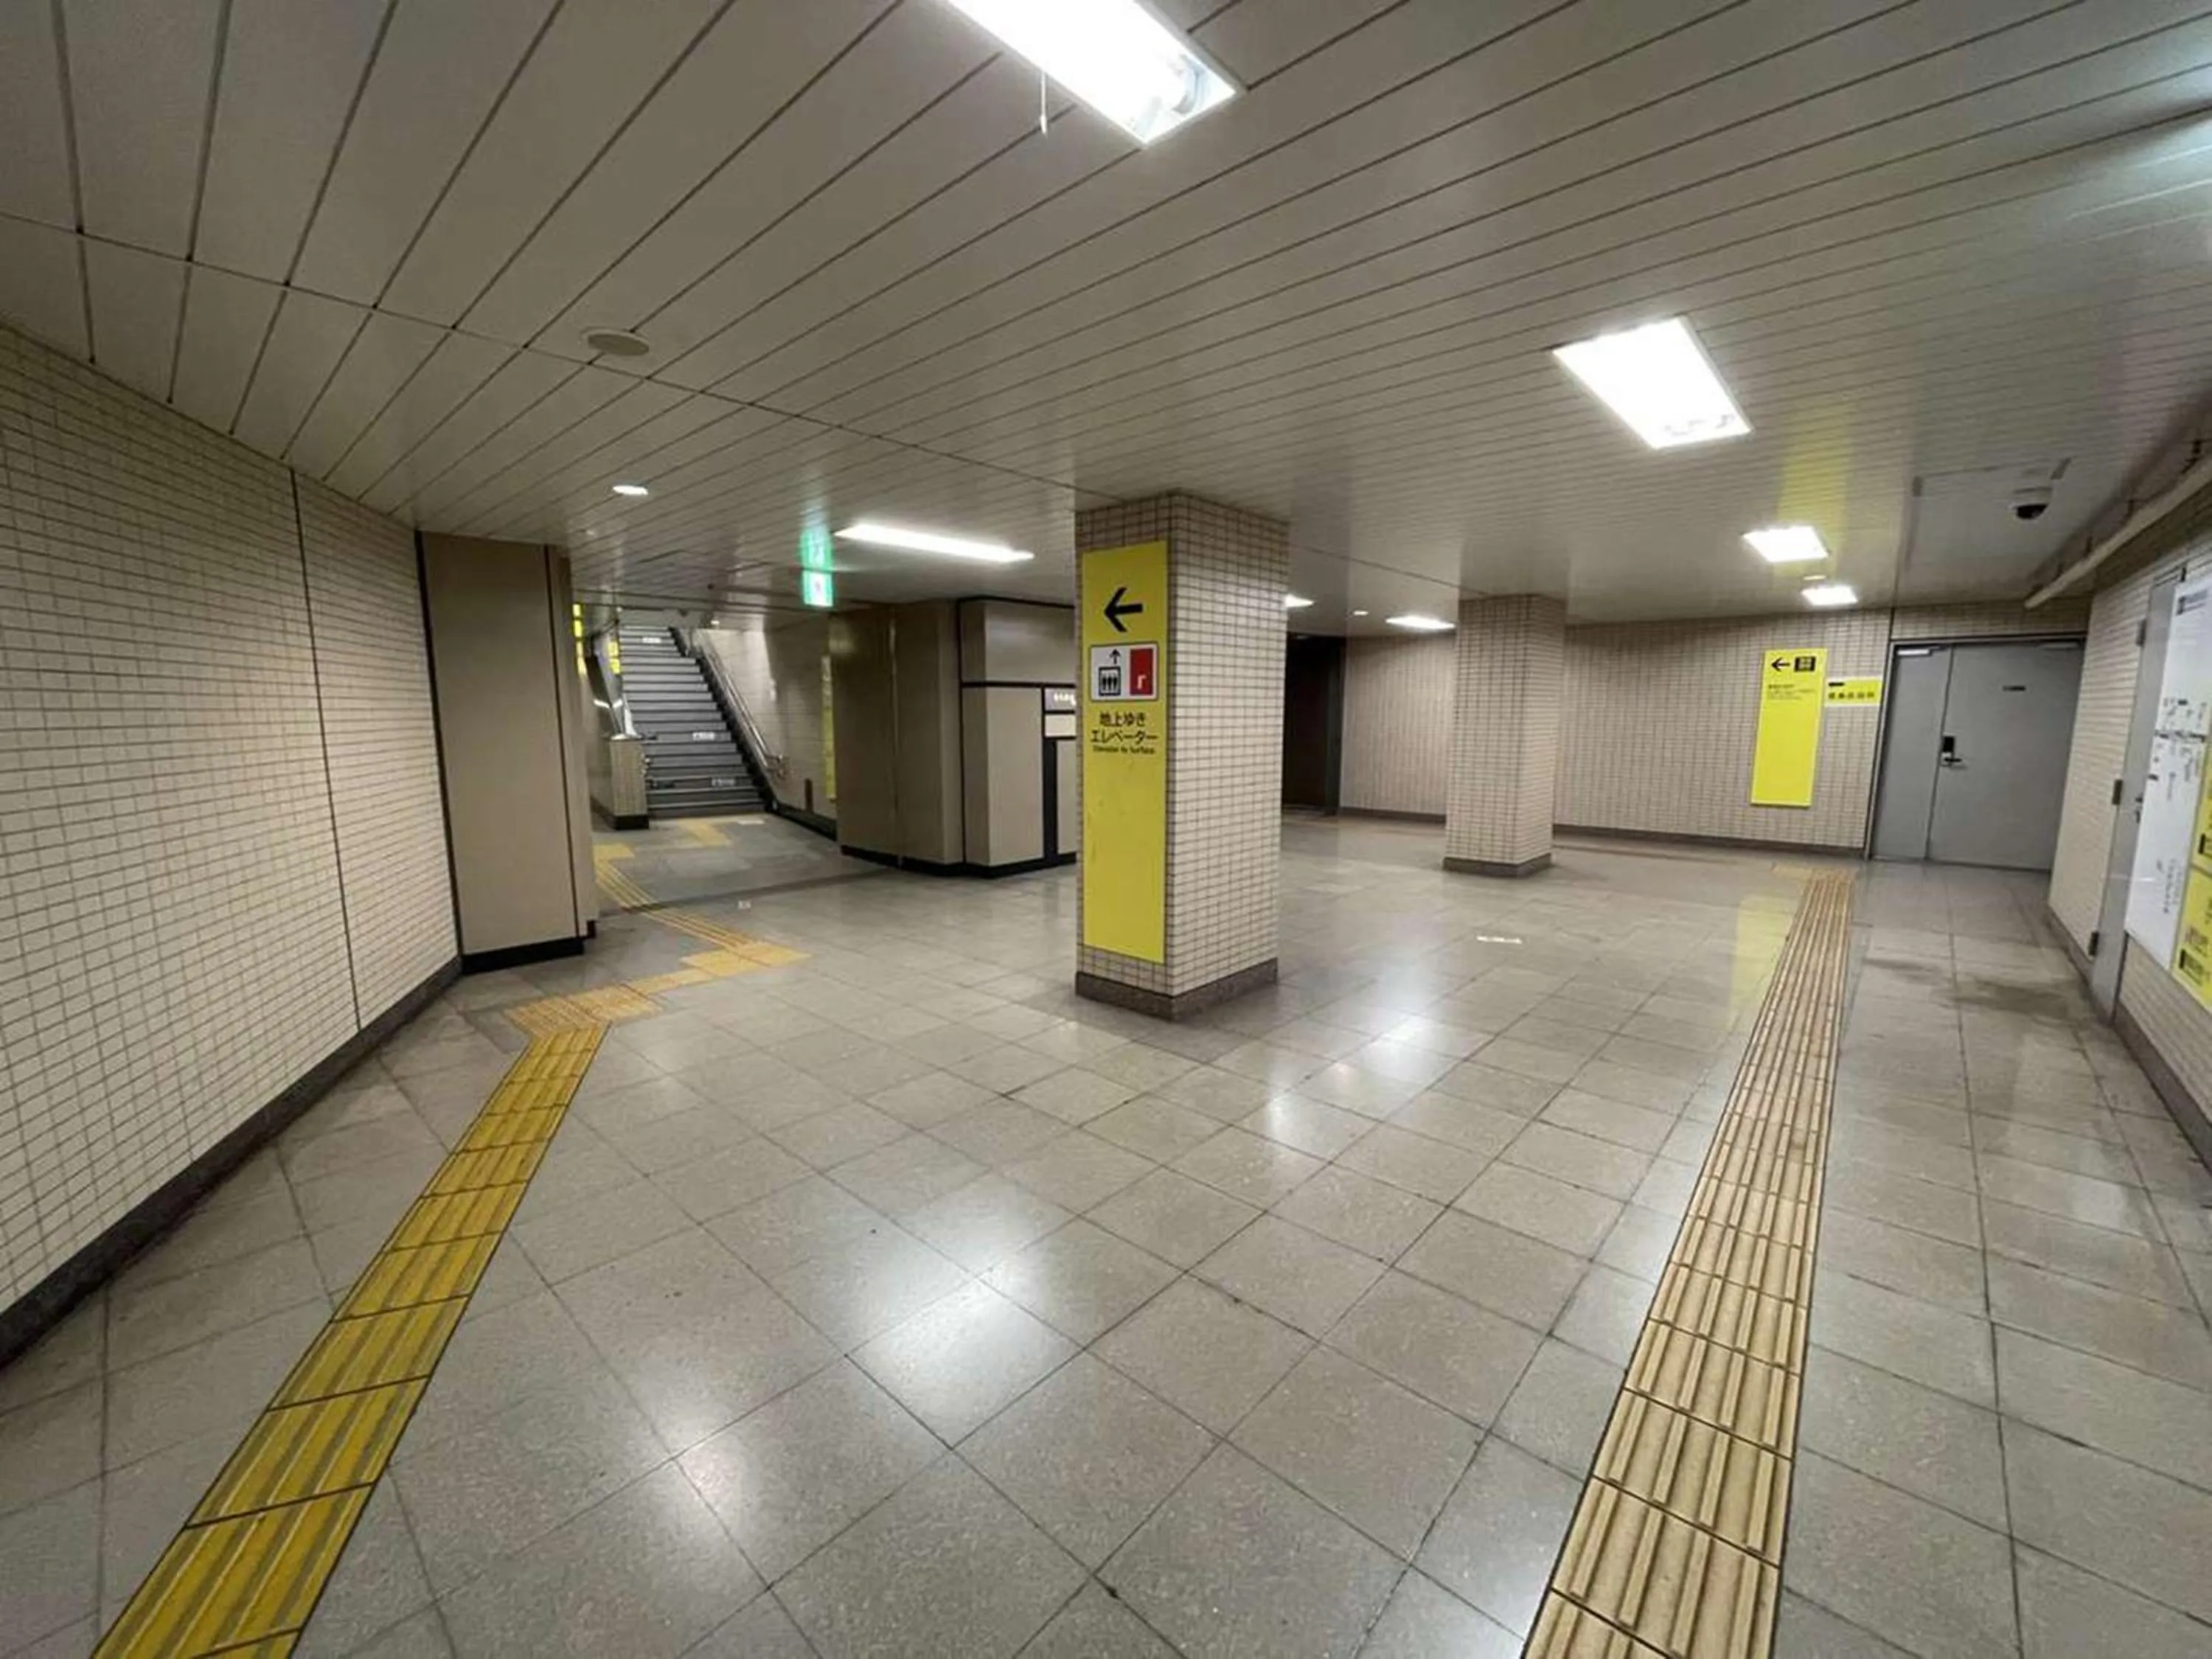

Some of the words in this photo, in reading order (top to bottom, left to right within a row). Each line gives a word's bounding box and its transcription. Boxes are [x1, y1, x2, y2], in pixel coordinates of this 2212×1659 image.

[1099, 712, 1146, 727] 地上ゆき
[1091, 728, 1158, 745] エレベーター
